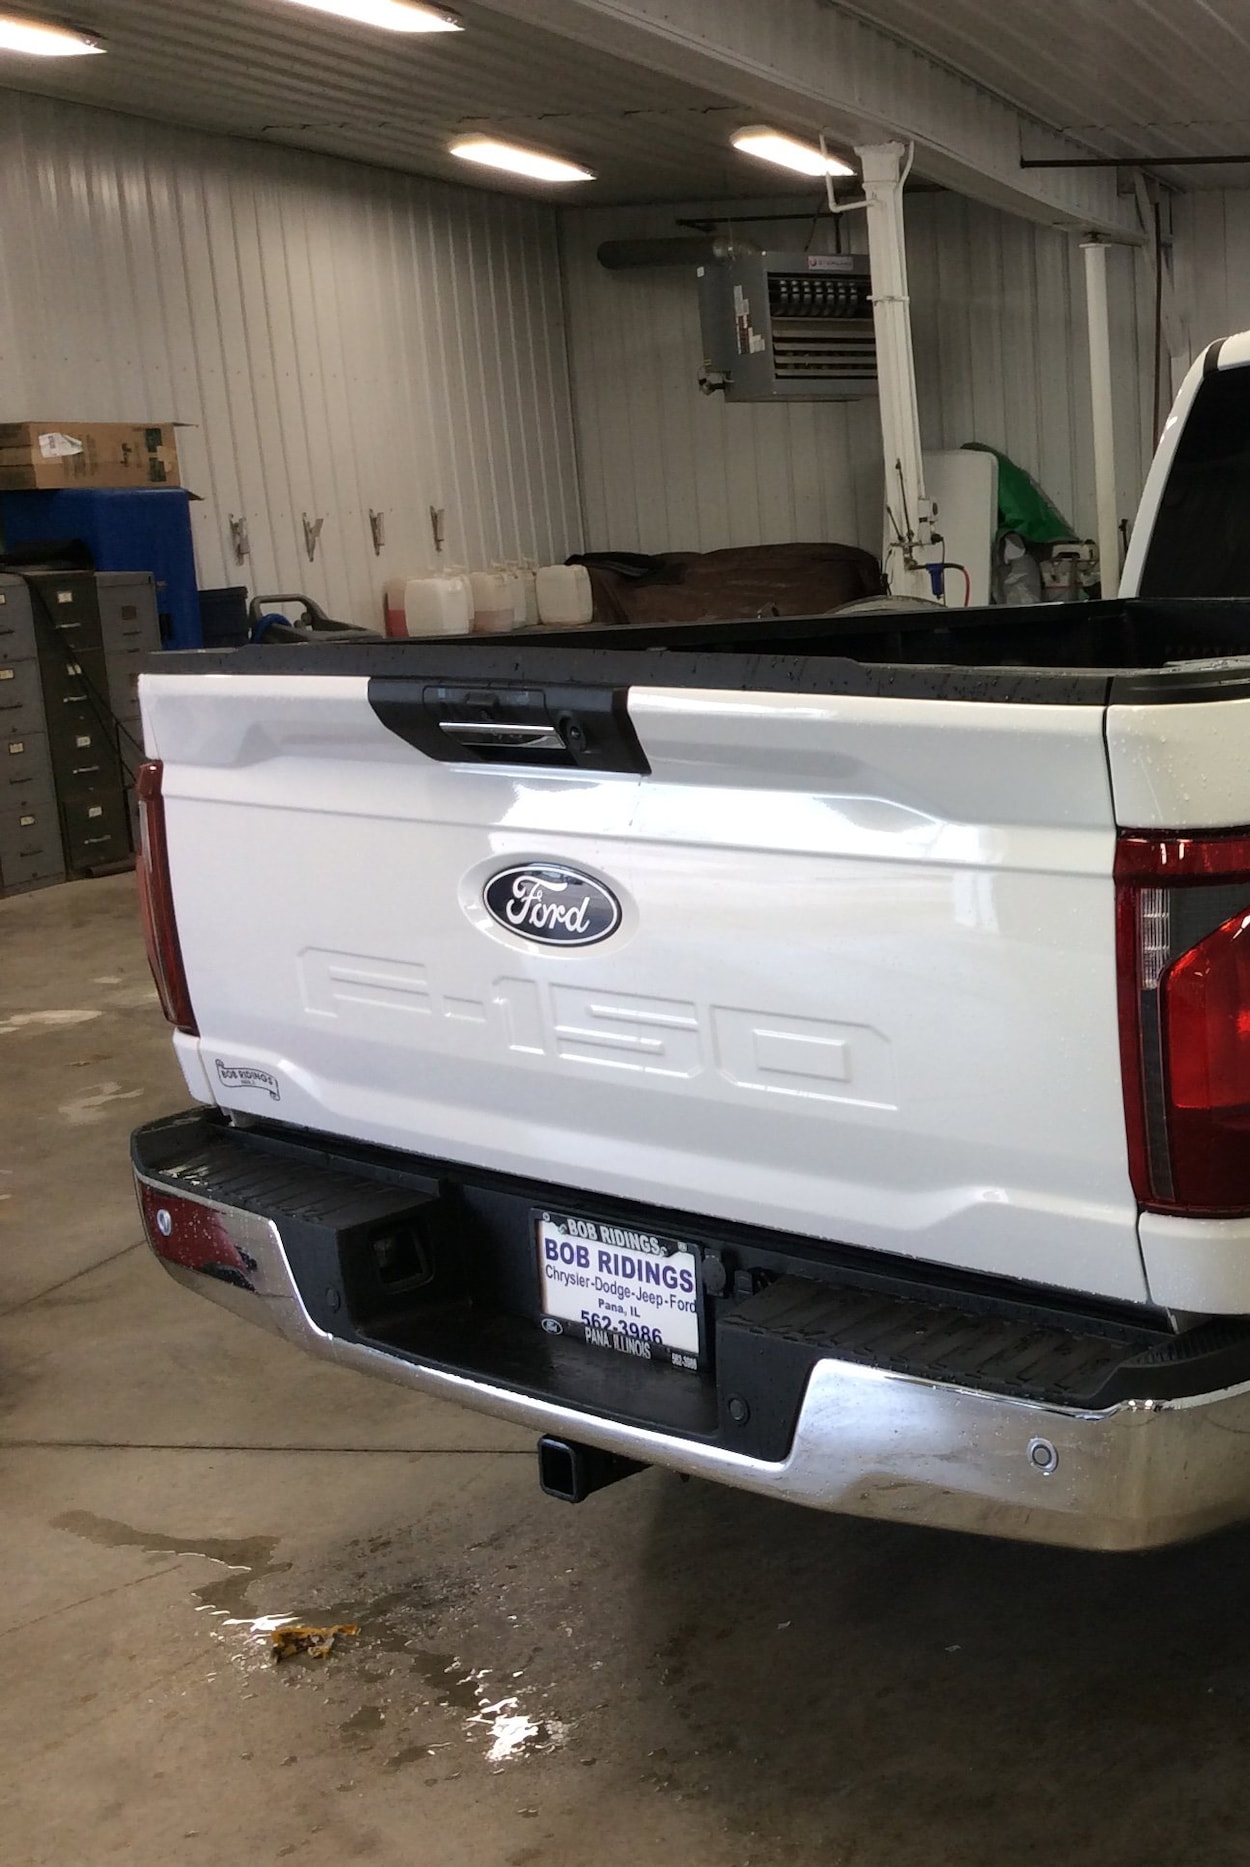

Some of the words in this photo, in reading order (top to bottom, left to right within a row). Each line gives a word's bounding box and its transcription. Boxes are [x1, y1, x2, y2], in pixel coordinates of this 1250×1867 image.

[506, 875, 591, 933] Ford
[299, 947, 898, 1110] F-150
[567, 1219, 597, 1241] BOB
[600, 1225, 660, 1254] RIDINGS
[544, 1237, 590, 1269] BOB
[598, 1250, 694, 1293] RIDINGS
[598, 1298, 627, 1316] Pana,
[630, 1305, 641, 1318] IL
[581, 1310, 663, 1344] 562-3986
[613, 1332, 651, 1360] ILLINOIS
